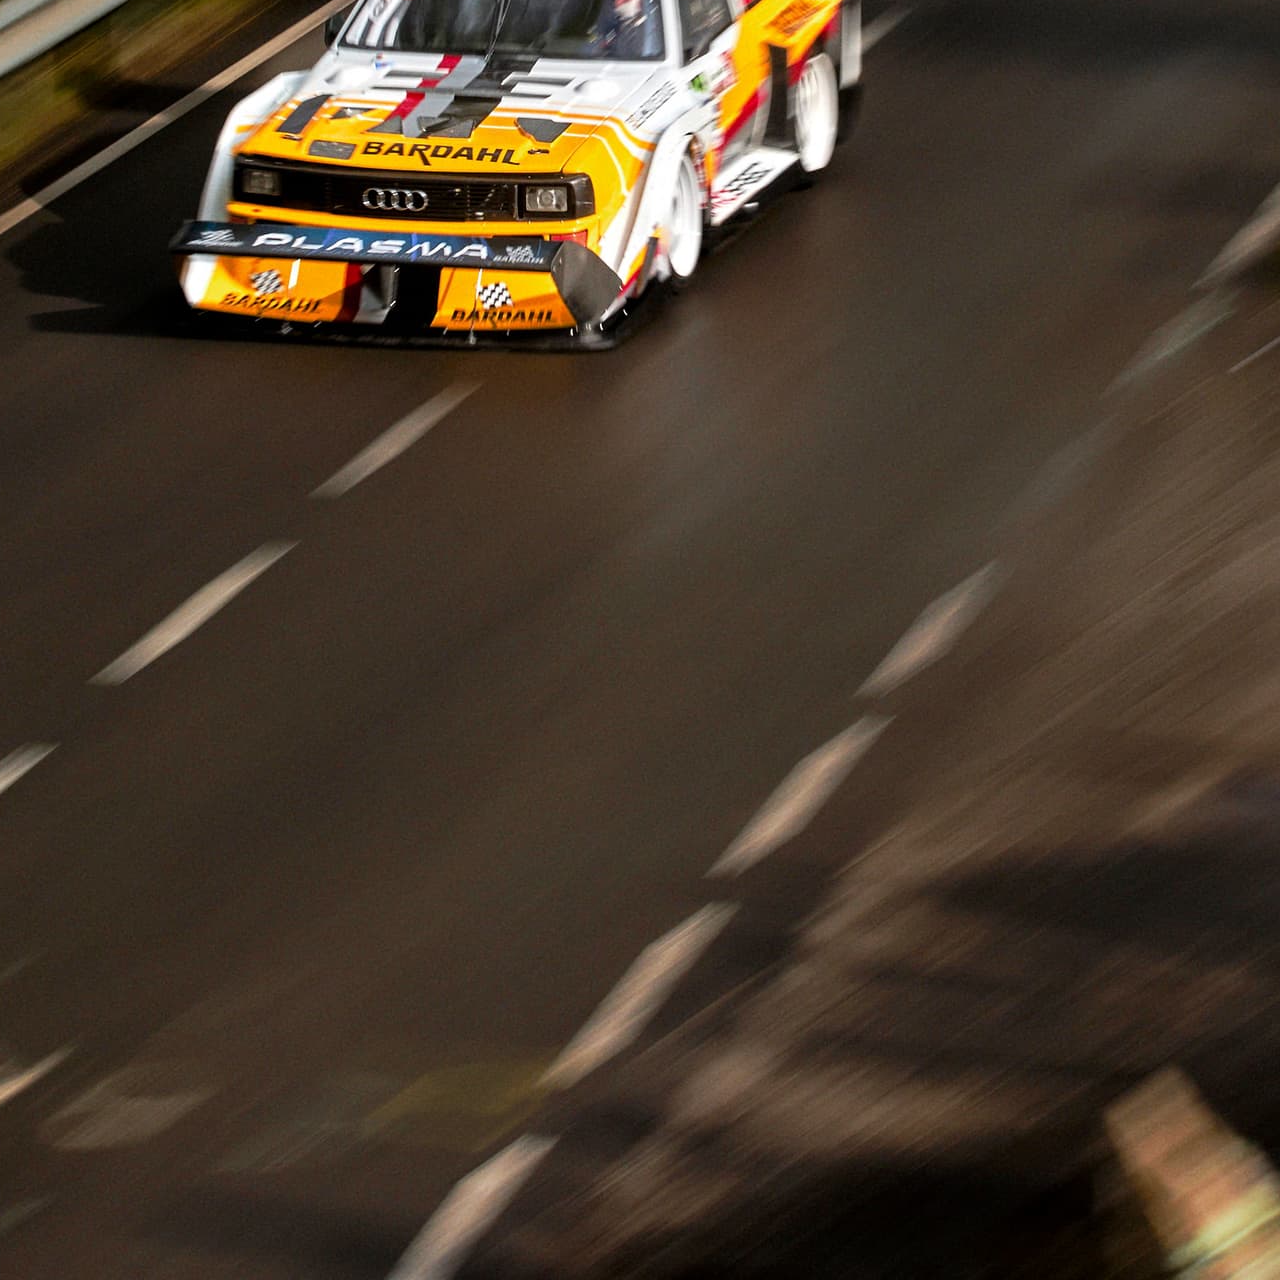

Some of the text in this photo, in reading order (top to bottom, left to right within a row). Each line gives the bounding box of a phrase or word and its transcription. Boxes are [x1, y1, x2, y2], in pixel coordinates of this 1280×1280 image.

[362, 141, 521, 166] BARDAHL
[251, 232, 489, 260] PLASMA
[220, 291, 322, 316] BARDAHL
[451, 308, 554, 329] BARDAHL
